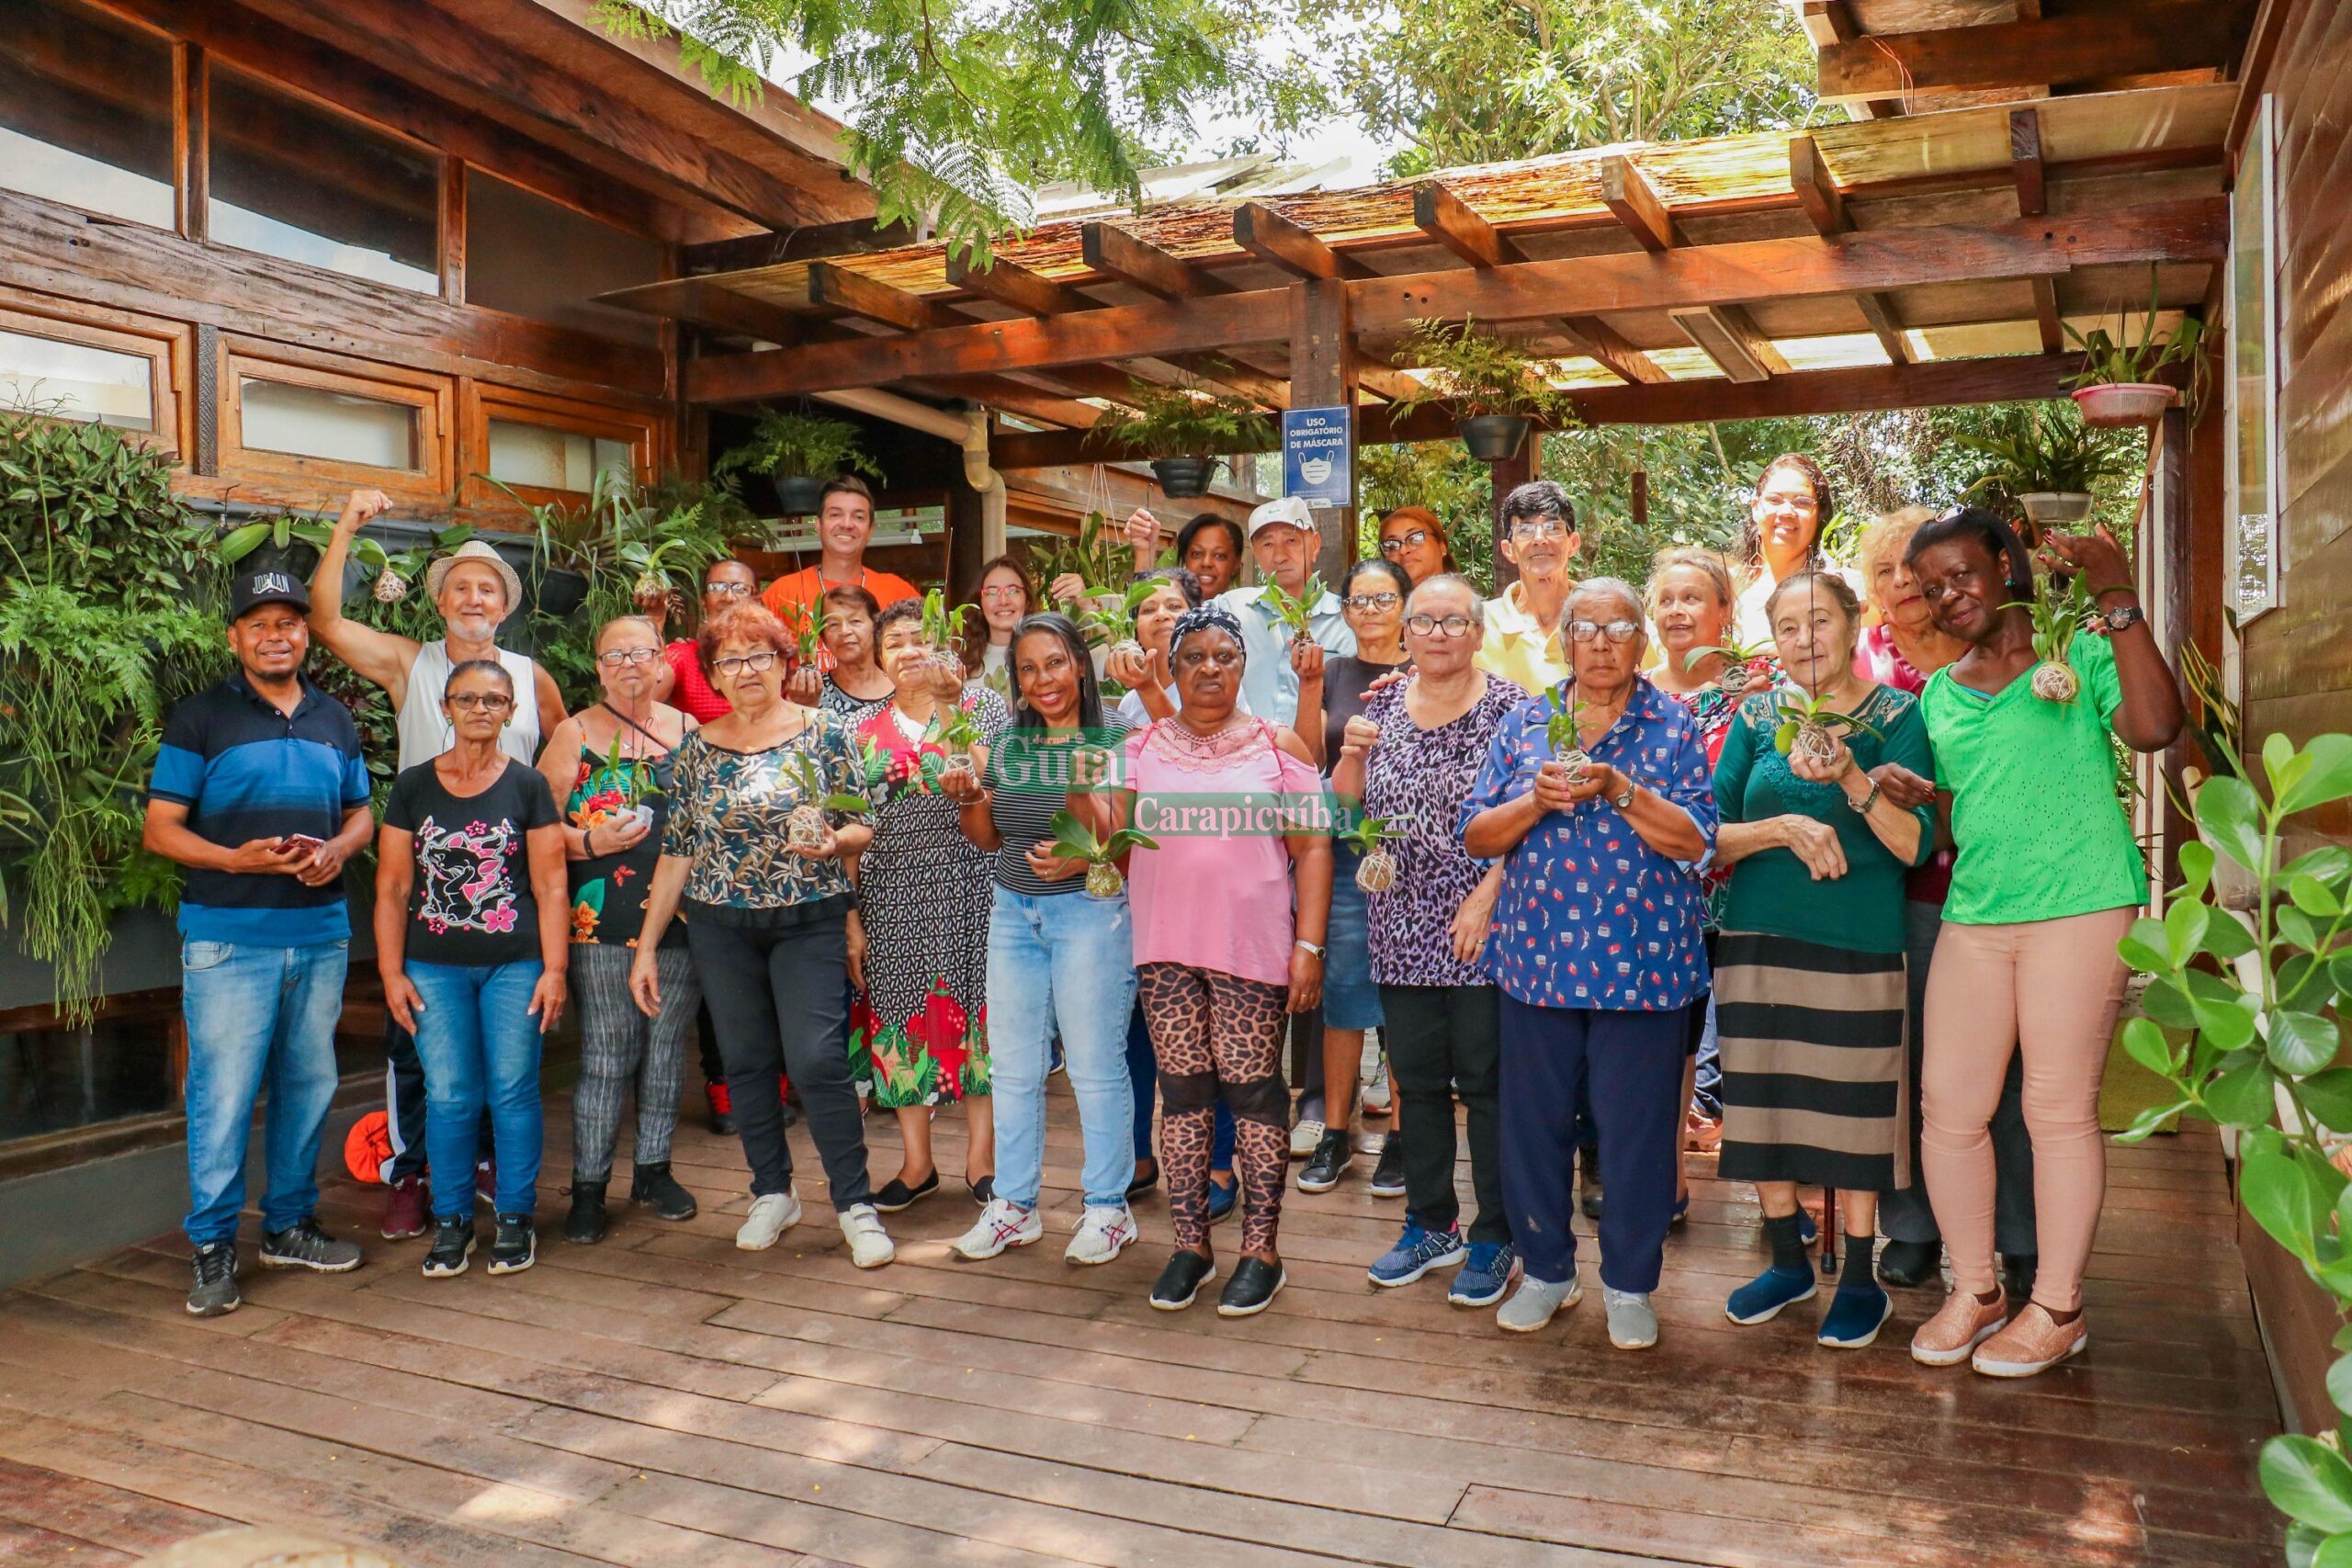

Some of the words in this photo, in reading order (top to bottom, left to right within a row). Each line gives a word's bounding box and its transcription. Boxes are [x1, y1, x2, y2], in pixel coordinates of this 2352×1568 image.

[1306, 417, 1326, 426] USO
[1289, 426, 1343, 437] OBRIGATÓRIO
[1290, 441, 1302, 449] DE
[1303, 437, 1344, 448] MÁSCARA
